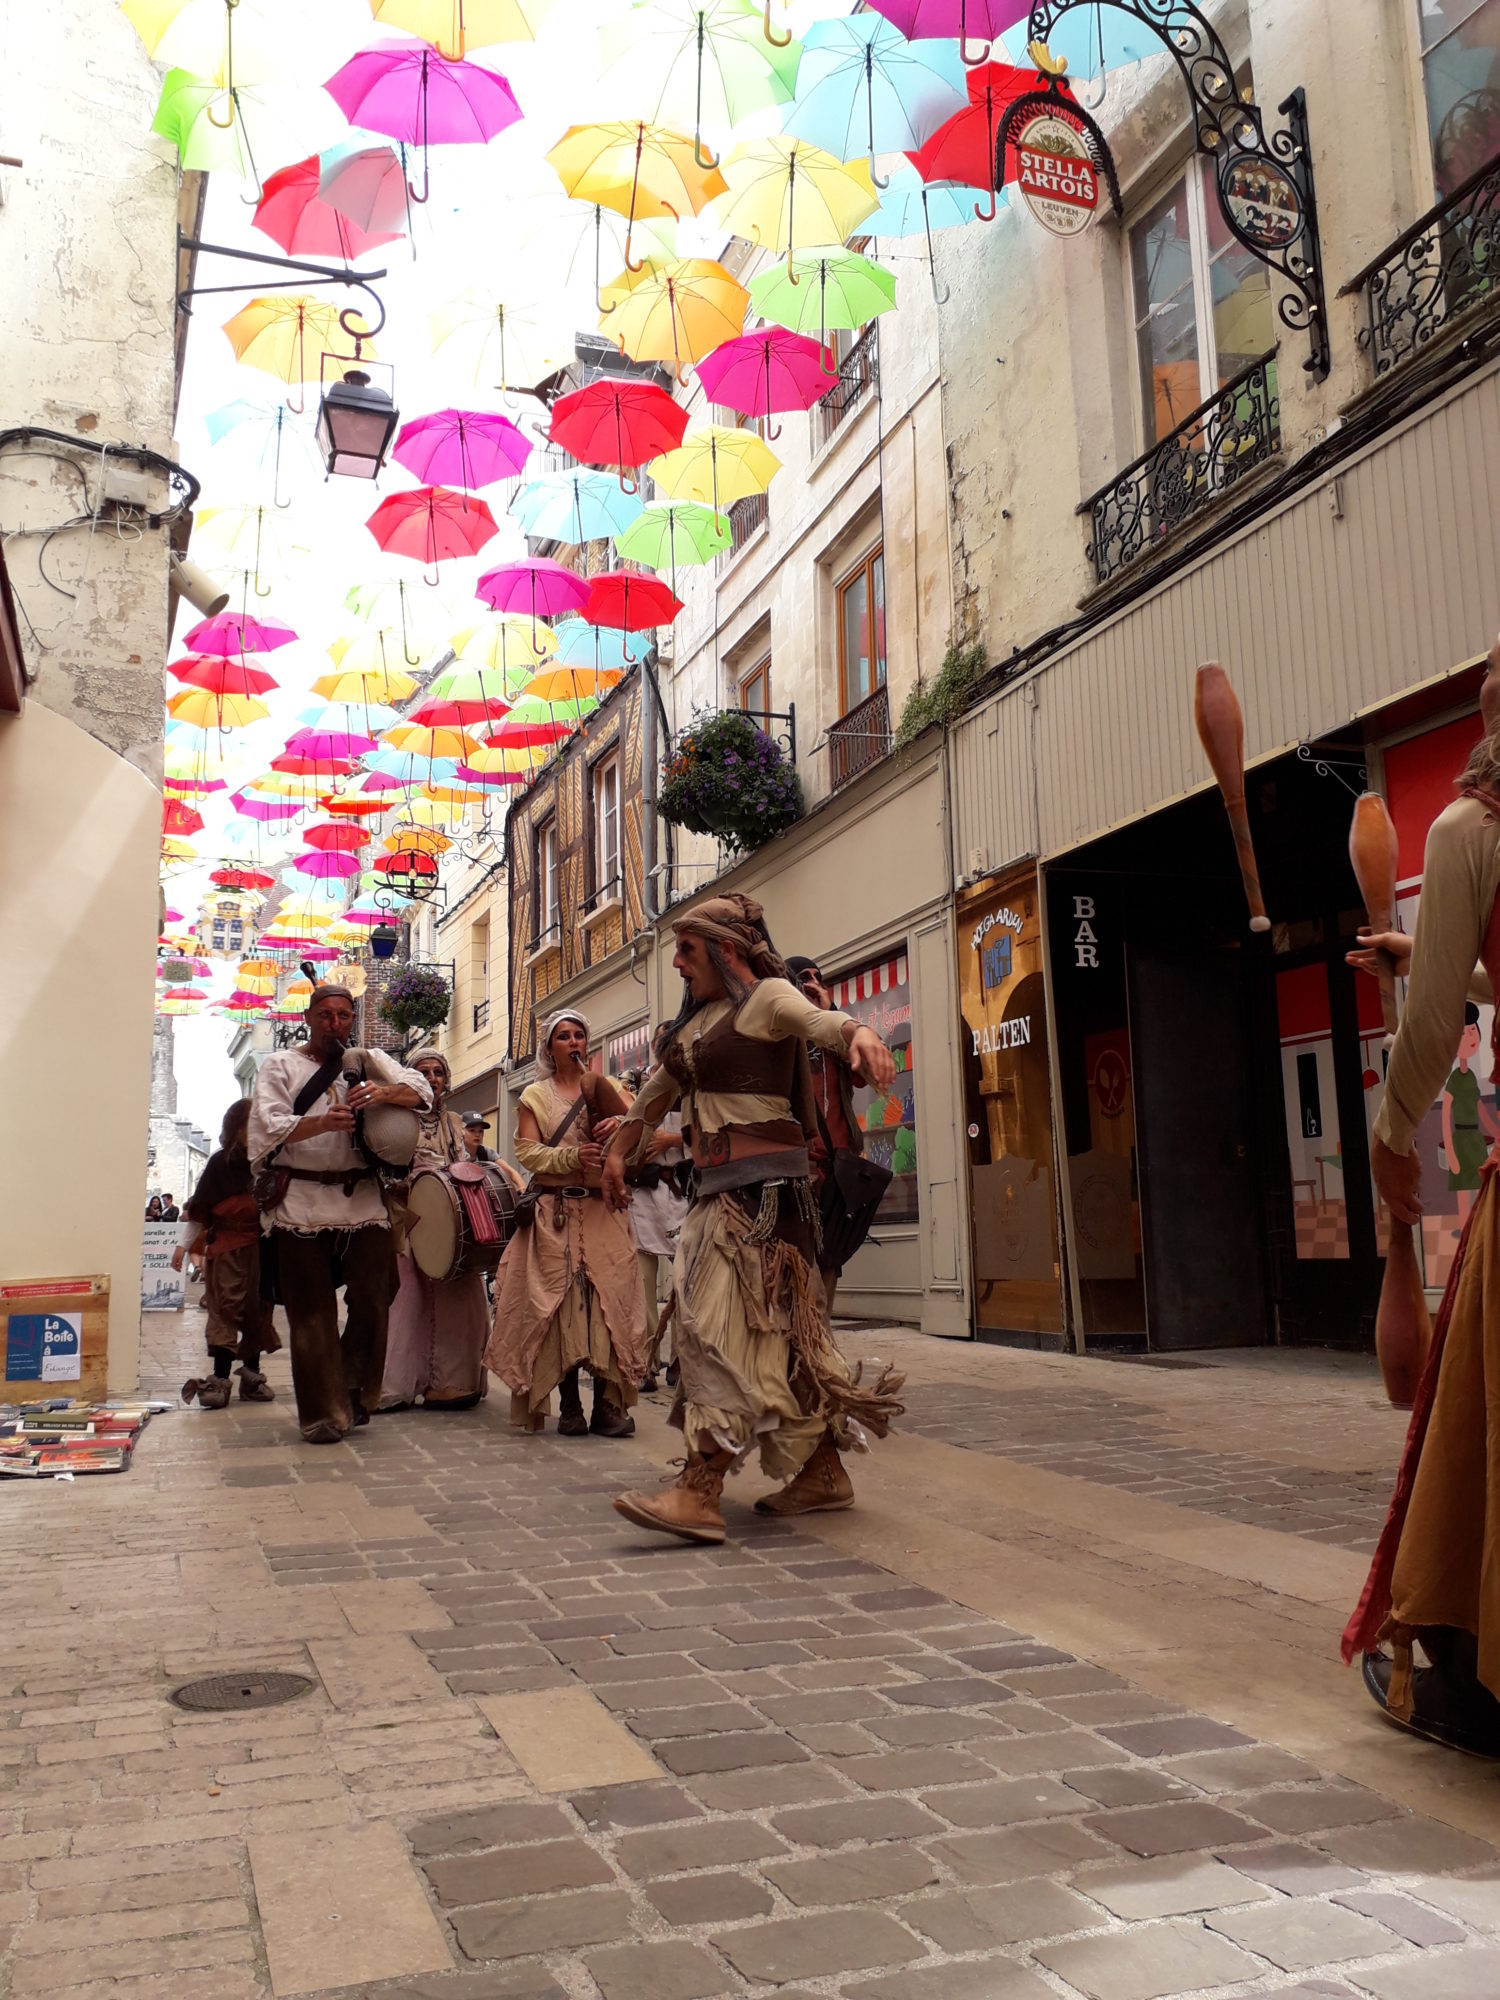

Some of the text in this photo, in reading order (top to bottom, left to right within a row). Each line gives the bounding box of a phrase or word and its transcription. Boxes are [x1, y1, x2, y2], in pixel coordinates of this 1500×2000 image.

[1020, 151, 1093, 184] STELLA
[1021, 169, 1095, 200] ARTOIS
[1041, 200, 1079, 217] LEUVEN
[1072, 896, 1100, 968] BAR
[972, 1016, 1031, 1056] PALTEN
[44, 1318, 60, 1330] La
